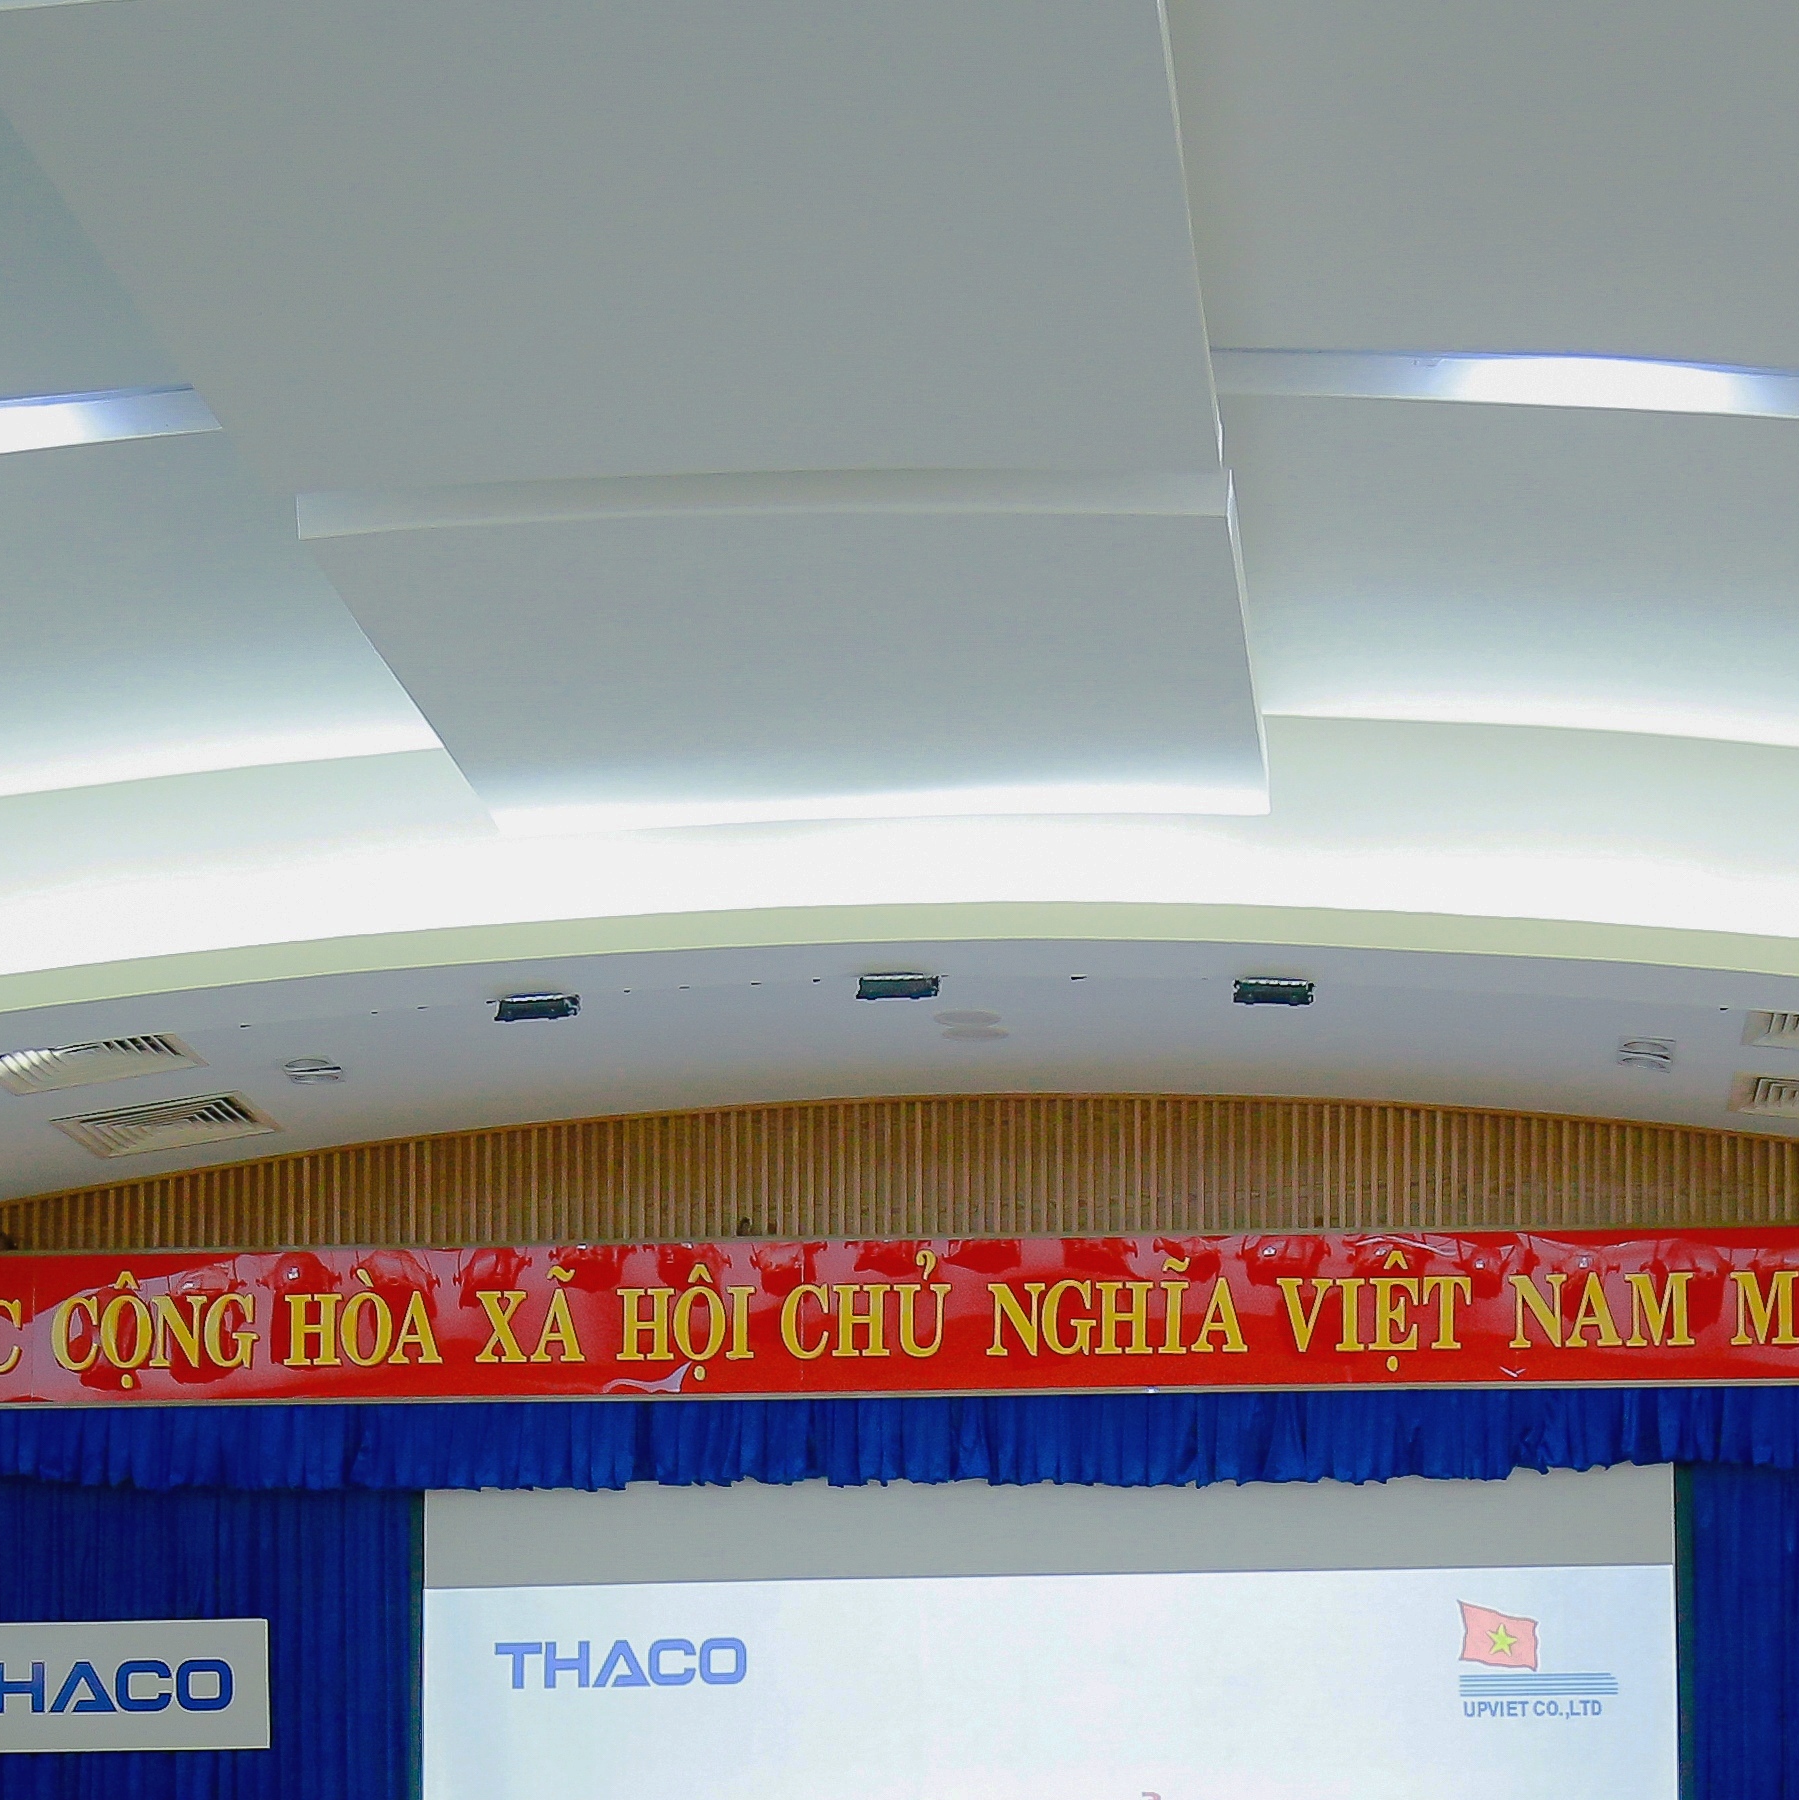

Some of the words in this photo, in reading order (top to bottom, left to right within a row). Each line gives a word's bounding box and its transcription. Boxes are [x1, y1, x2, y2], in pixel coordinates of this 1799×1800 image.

[54, 1272, 256, 1389] CỘNG
[285, 1266, 442, 1367] HÒA
[476, 1268, 582, 1364] XÃ
[617, 1263, 755, 1378] HỘI
[781, 1249, 951, 1360] CHỦ
[985, 1258, 1246, 1356] NGHĨA
[1277, 1250, 1470, 1373] VIỆT
[1510, 1272, 1694, 1349] NAM
[494, 1638, 747, 1689] THACO
[1462, 1699, 1529, 1719] UPVIET
